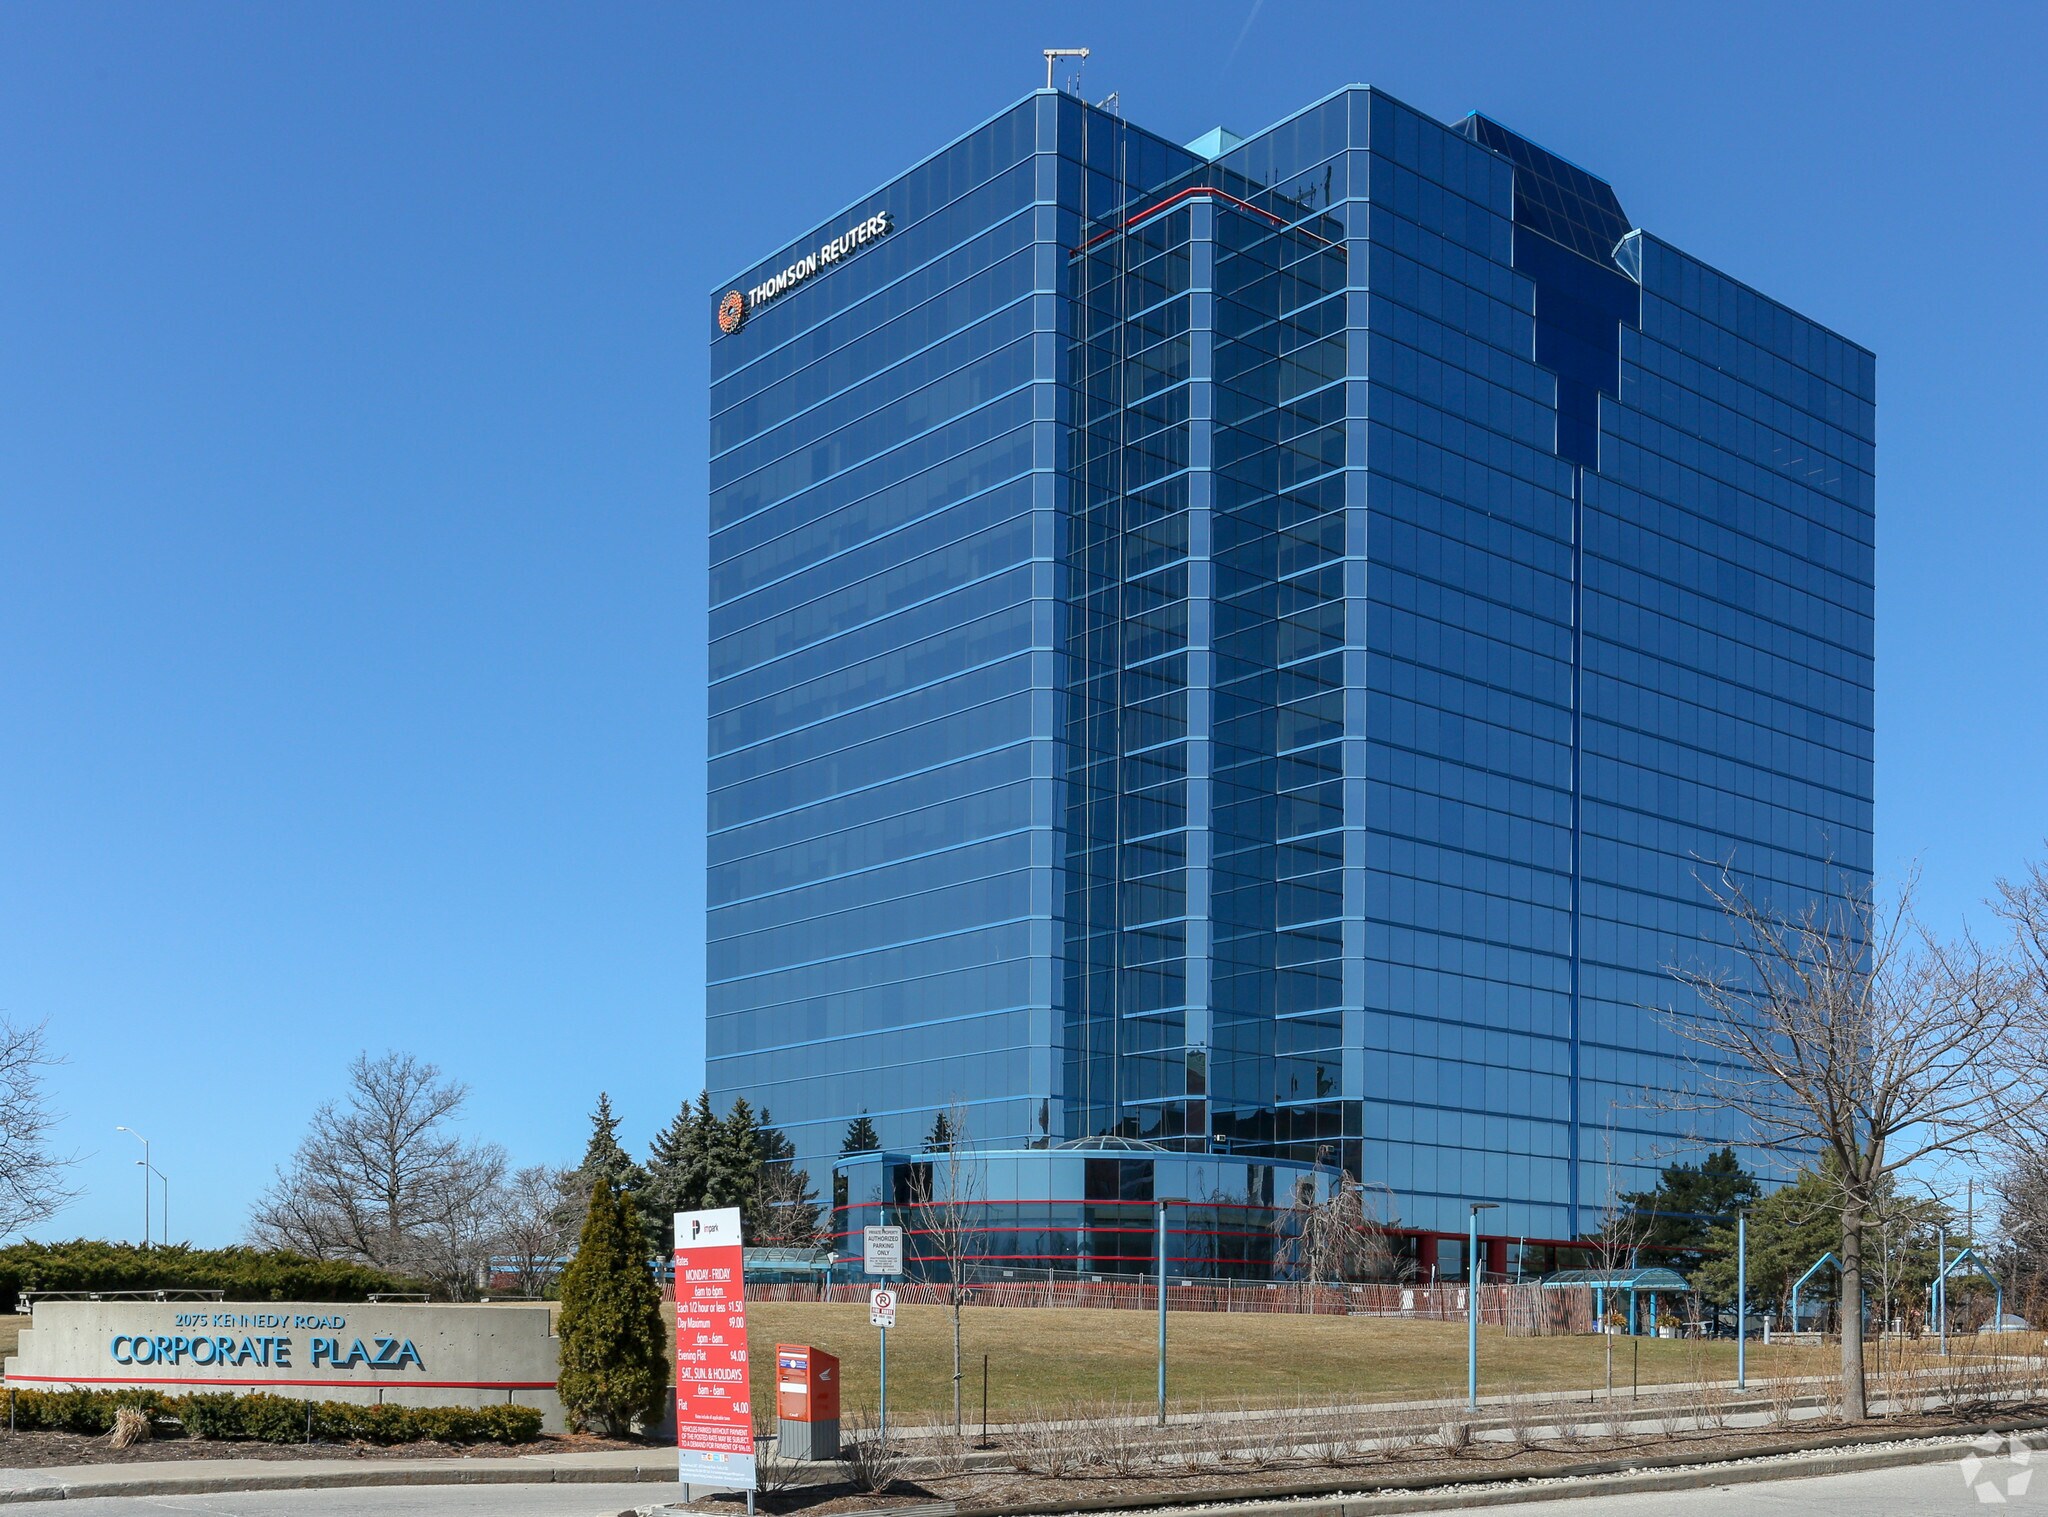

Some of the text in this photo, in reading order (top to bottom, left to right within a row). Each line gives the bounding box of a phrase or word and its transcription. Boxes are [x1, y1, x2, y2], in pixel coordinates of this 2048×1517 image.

[749, 211, 886, 307] THOMSON REUTERS
[704, 1224, 719, 1234] impark
[676, 1255, 688, 1266] Rates
[685, 1269, 708, 1280] MONDAY
[712, 1268, 731, 1279] FRIDAY
[694, 1285, 723, 1298] 6am to 6pm
[677, 1301, 743, 1313] Each 1/2 hour or less $1.50
[175, 1313, 345, 1329] 2075 KENNEDY ROAD
[677, 1316, 744, 1331] Day Maximum $9.00
[697, 1332, 708, 1345] 6pm
[712, 1332, 723, 1343] 6am
[110, 1335, 421, 1366] CORPORATE PLAZA
[678, 1349, 746, 1364] Evening Flat $4.00
[694, 1367, 707, 1379] SUN.
[708, 1367, 713, 1379] &
[713, 1368, 743, 1380] HOLIDAYS
[698, 1384, 709, 1395] 6am
[713, 1384, 725, 1395] 6am
[678, 1398, 748, 1414] Flat $4.00
[732, 1436, 749, 1444] SUBJECT
